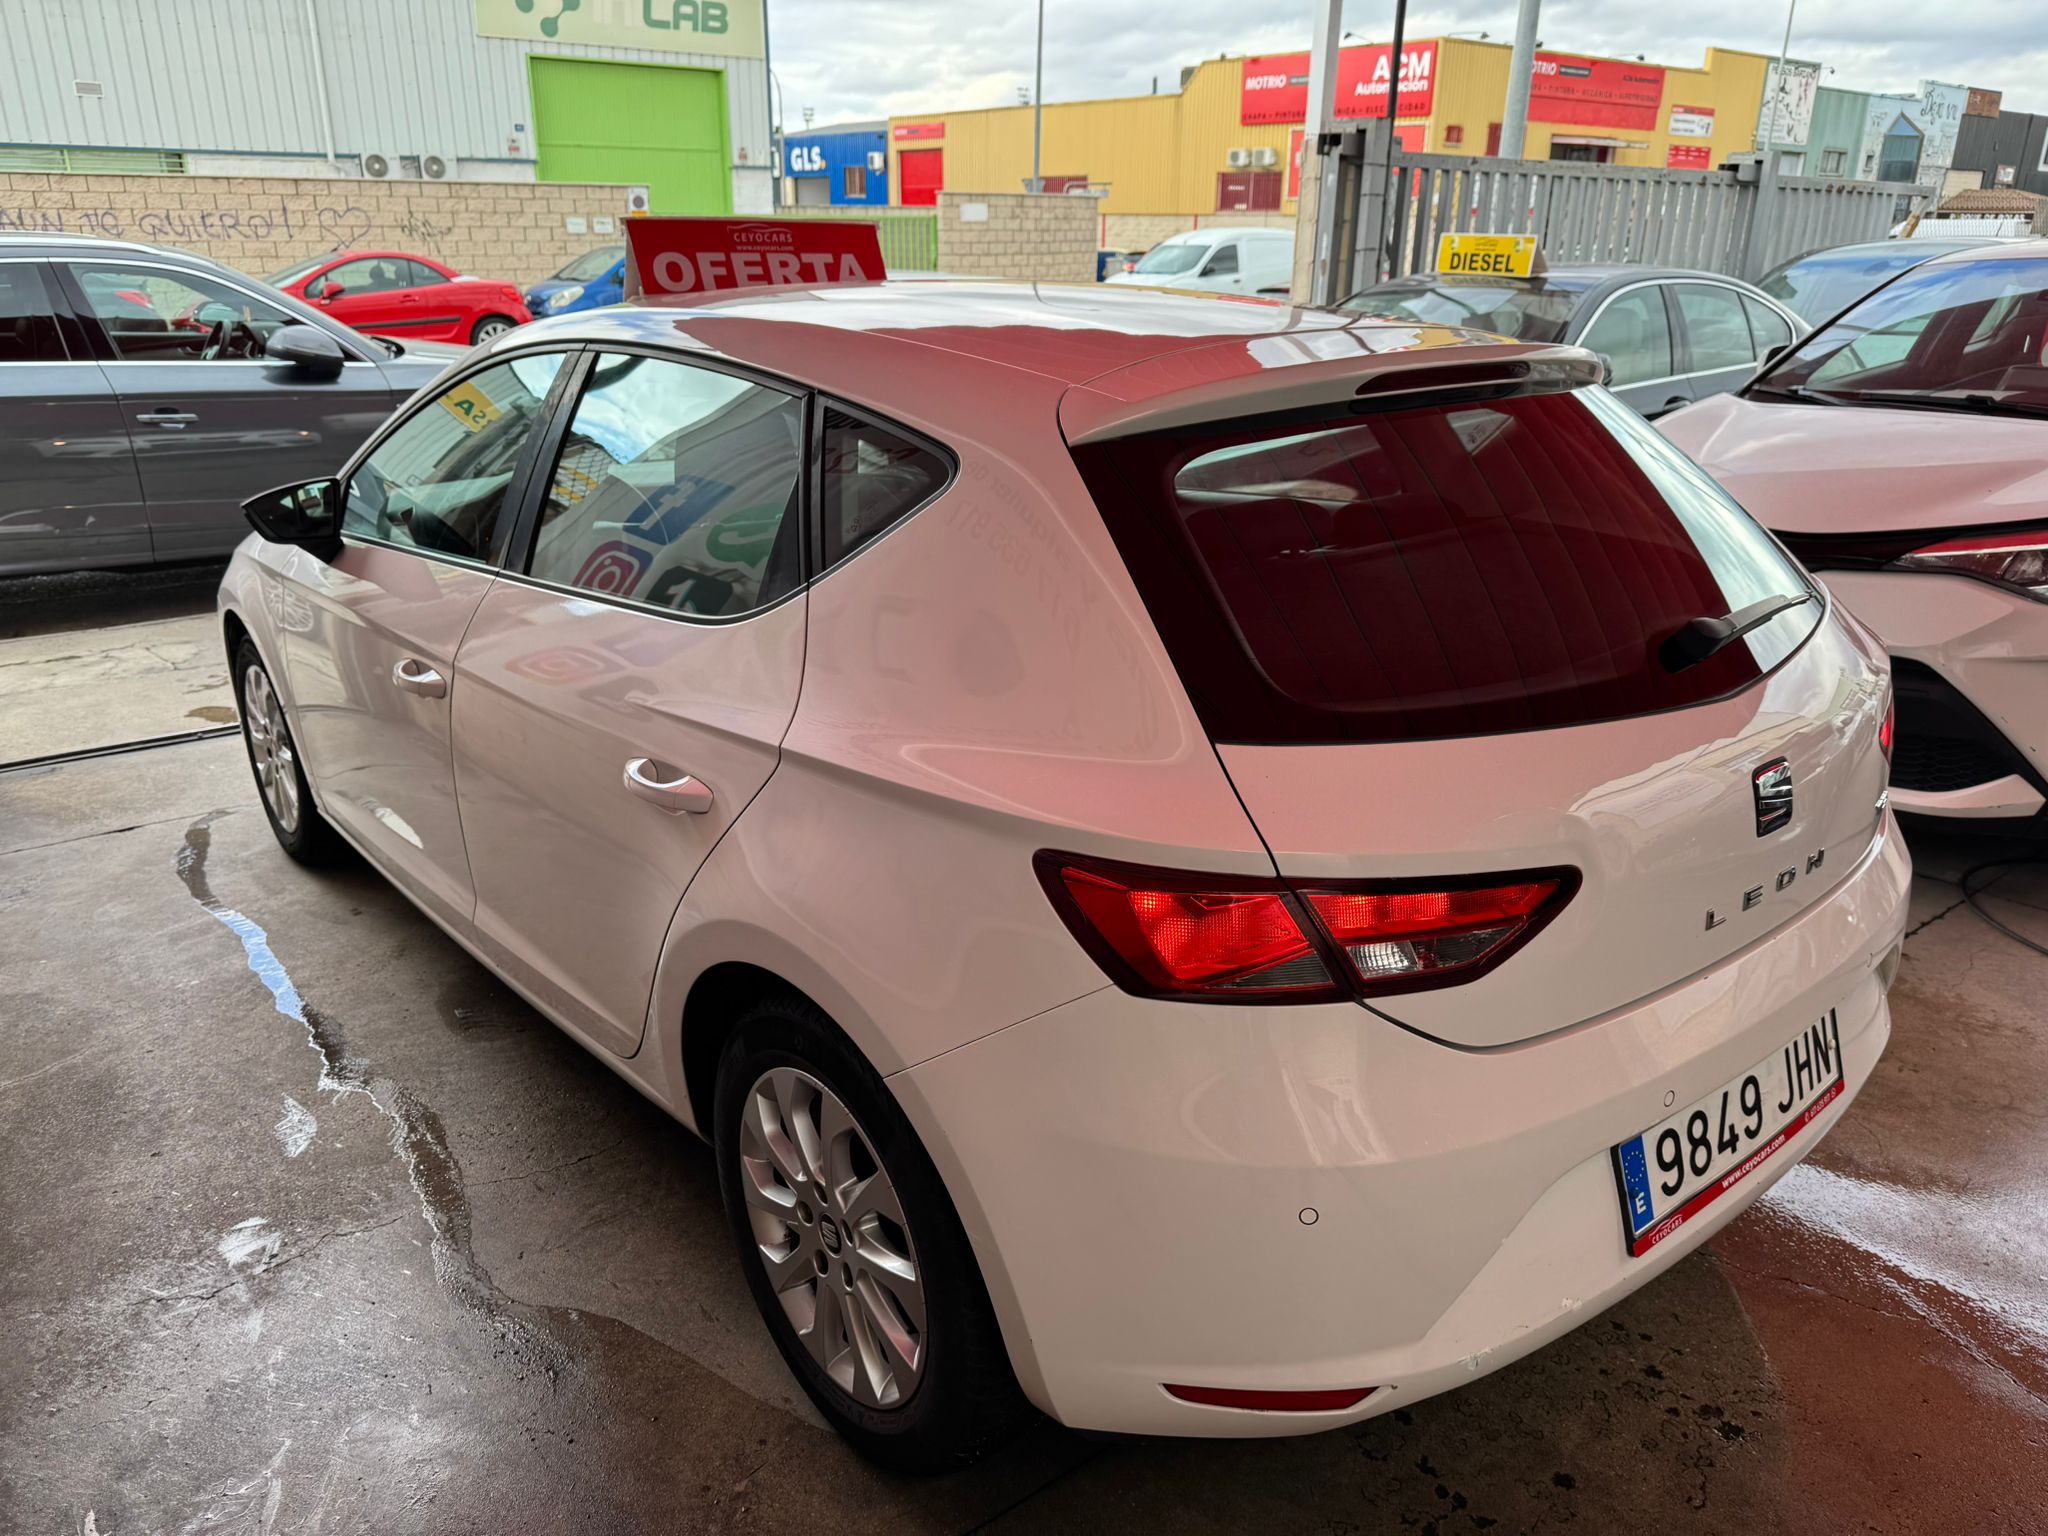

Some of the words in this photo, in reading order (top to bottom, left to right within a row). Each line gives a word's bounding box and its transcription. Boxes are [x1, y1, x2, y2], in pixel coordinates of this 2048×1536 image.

[1245, 74, 1287, 91] MOTRIO
[733, 232, 793, 243] CEYOCARS
[653, 251, 868, 292] OFERTA
[1449, 252, 1515, 273] DIESEL
[1705, 848, 1825, 931] LEON
[1656, 1075, 1763, 1197] 9849
[1778, 1016, 1832, 1114] JHN
[1721, 1134, 1786, 1189] www.ceyocars.com
[1635, 1192, 1647, 1215] E
[1652, 1217, 1684, 1245] CEYOCARS
